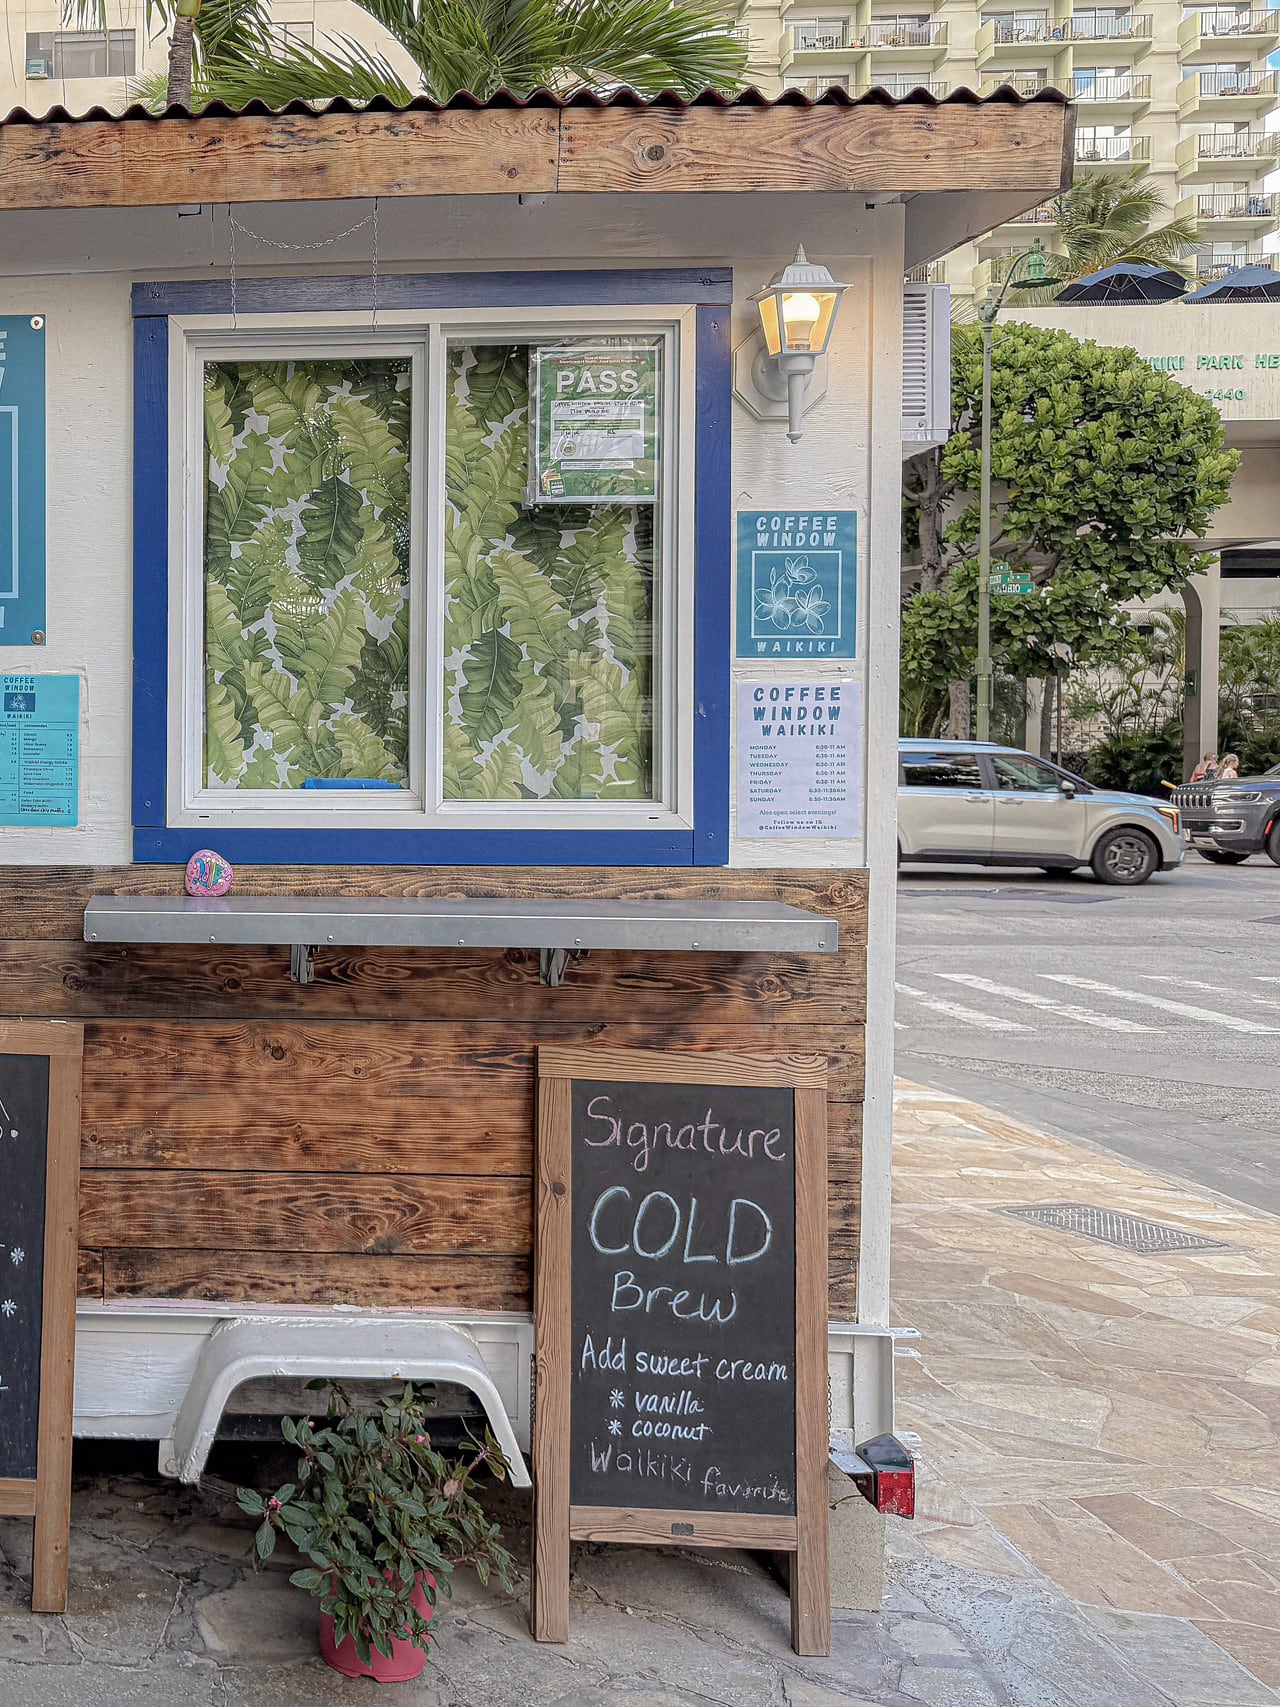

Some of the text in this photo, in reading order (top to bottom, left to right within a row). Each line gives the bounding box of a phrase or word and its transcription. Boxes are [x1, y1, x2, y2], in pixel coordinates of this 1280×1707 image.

[1144, 356, 1185, 370] KIKI
[1197, 355, 1244, 369] PARK
[557, 370, 638, 392] PASS
[1205, 389, 1246, 400] 2440
[756, 516, 837, 530] COFFEE
[756, 532, 836, 546] WINDOW
[756, 641, 835, 653] WAIKIKI
[754, 686, 840, 702] COFFEE
[754, 706, 840, 720] WINDOW
[762, 724, 834, 736] WAIKIKI
[584, 1096, 786, 1172] Signature
[589, 1185, 772, 1265] COLD
[610, 1270, 738, 1324] Brew
[580, 1334, 788, 1380] Add sweet cream
[634, 1390, 705, 1414] vanilla
[632, 1419, 710, 1442] coconut
[591, 1442, 691, 1482] Waikiki
